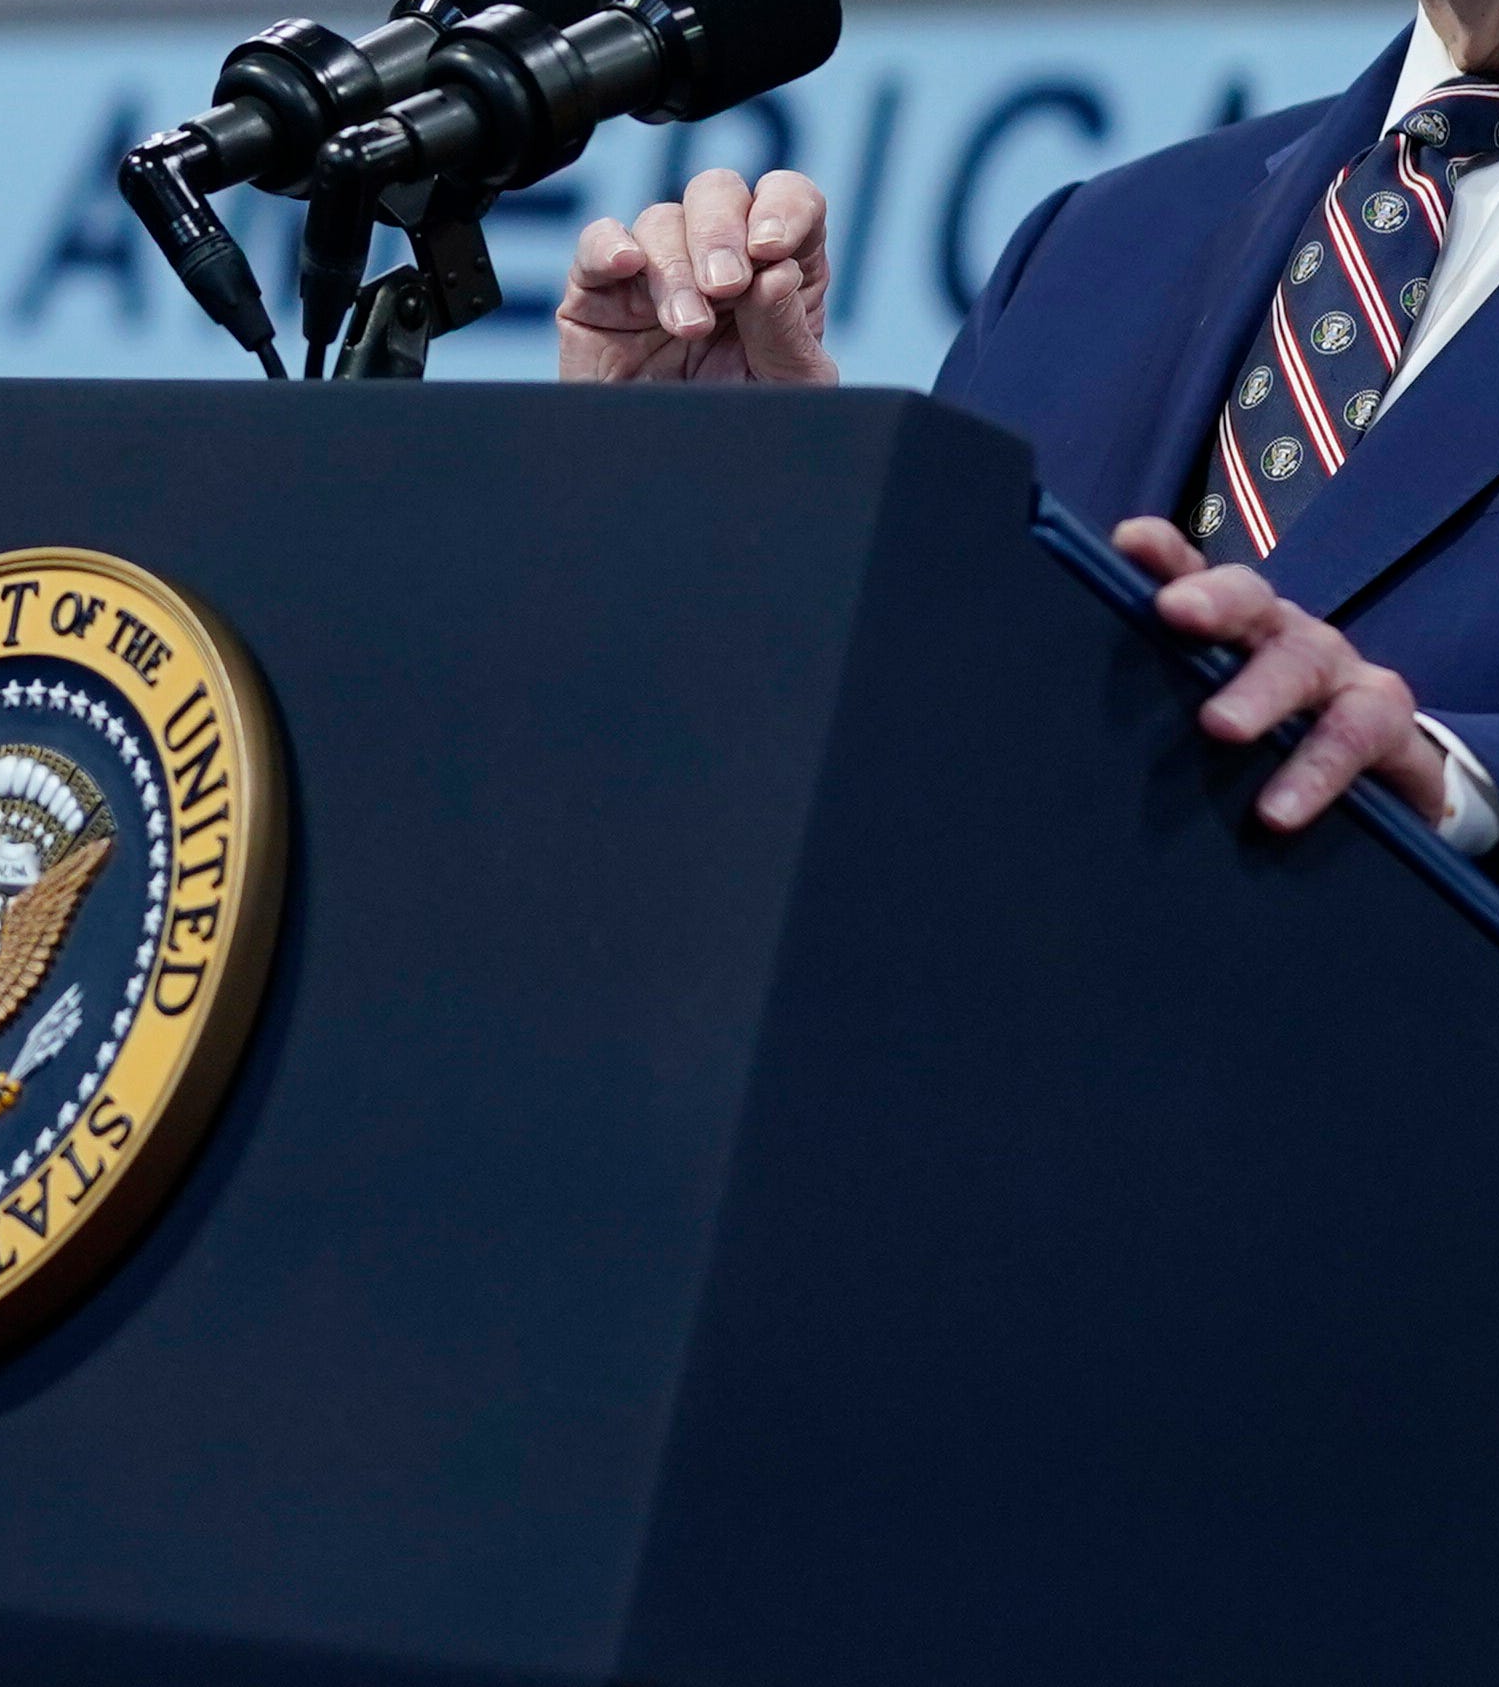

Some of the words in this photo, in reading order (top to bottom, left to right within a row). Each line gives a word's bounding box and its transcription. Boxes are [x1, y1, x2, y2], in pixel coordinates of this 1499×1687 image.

[50, 590, 107, 640] OF
[105, 607, 174, 689] THE
[153, 680, 231, 1017] UNITED
